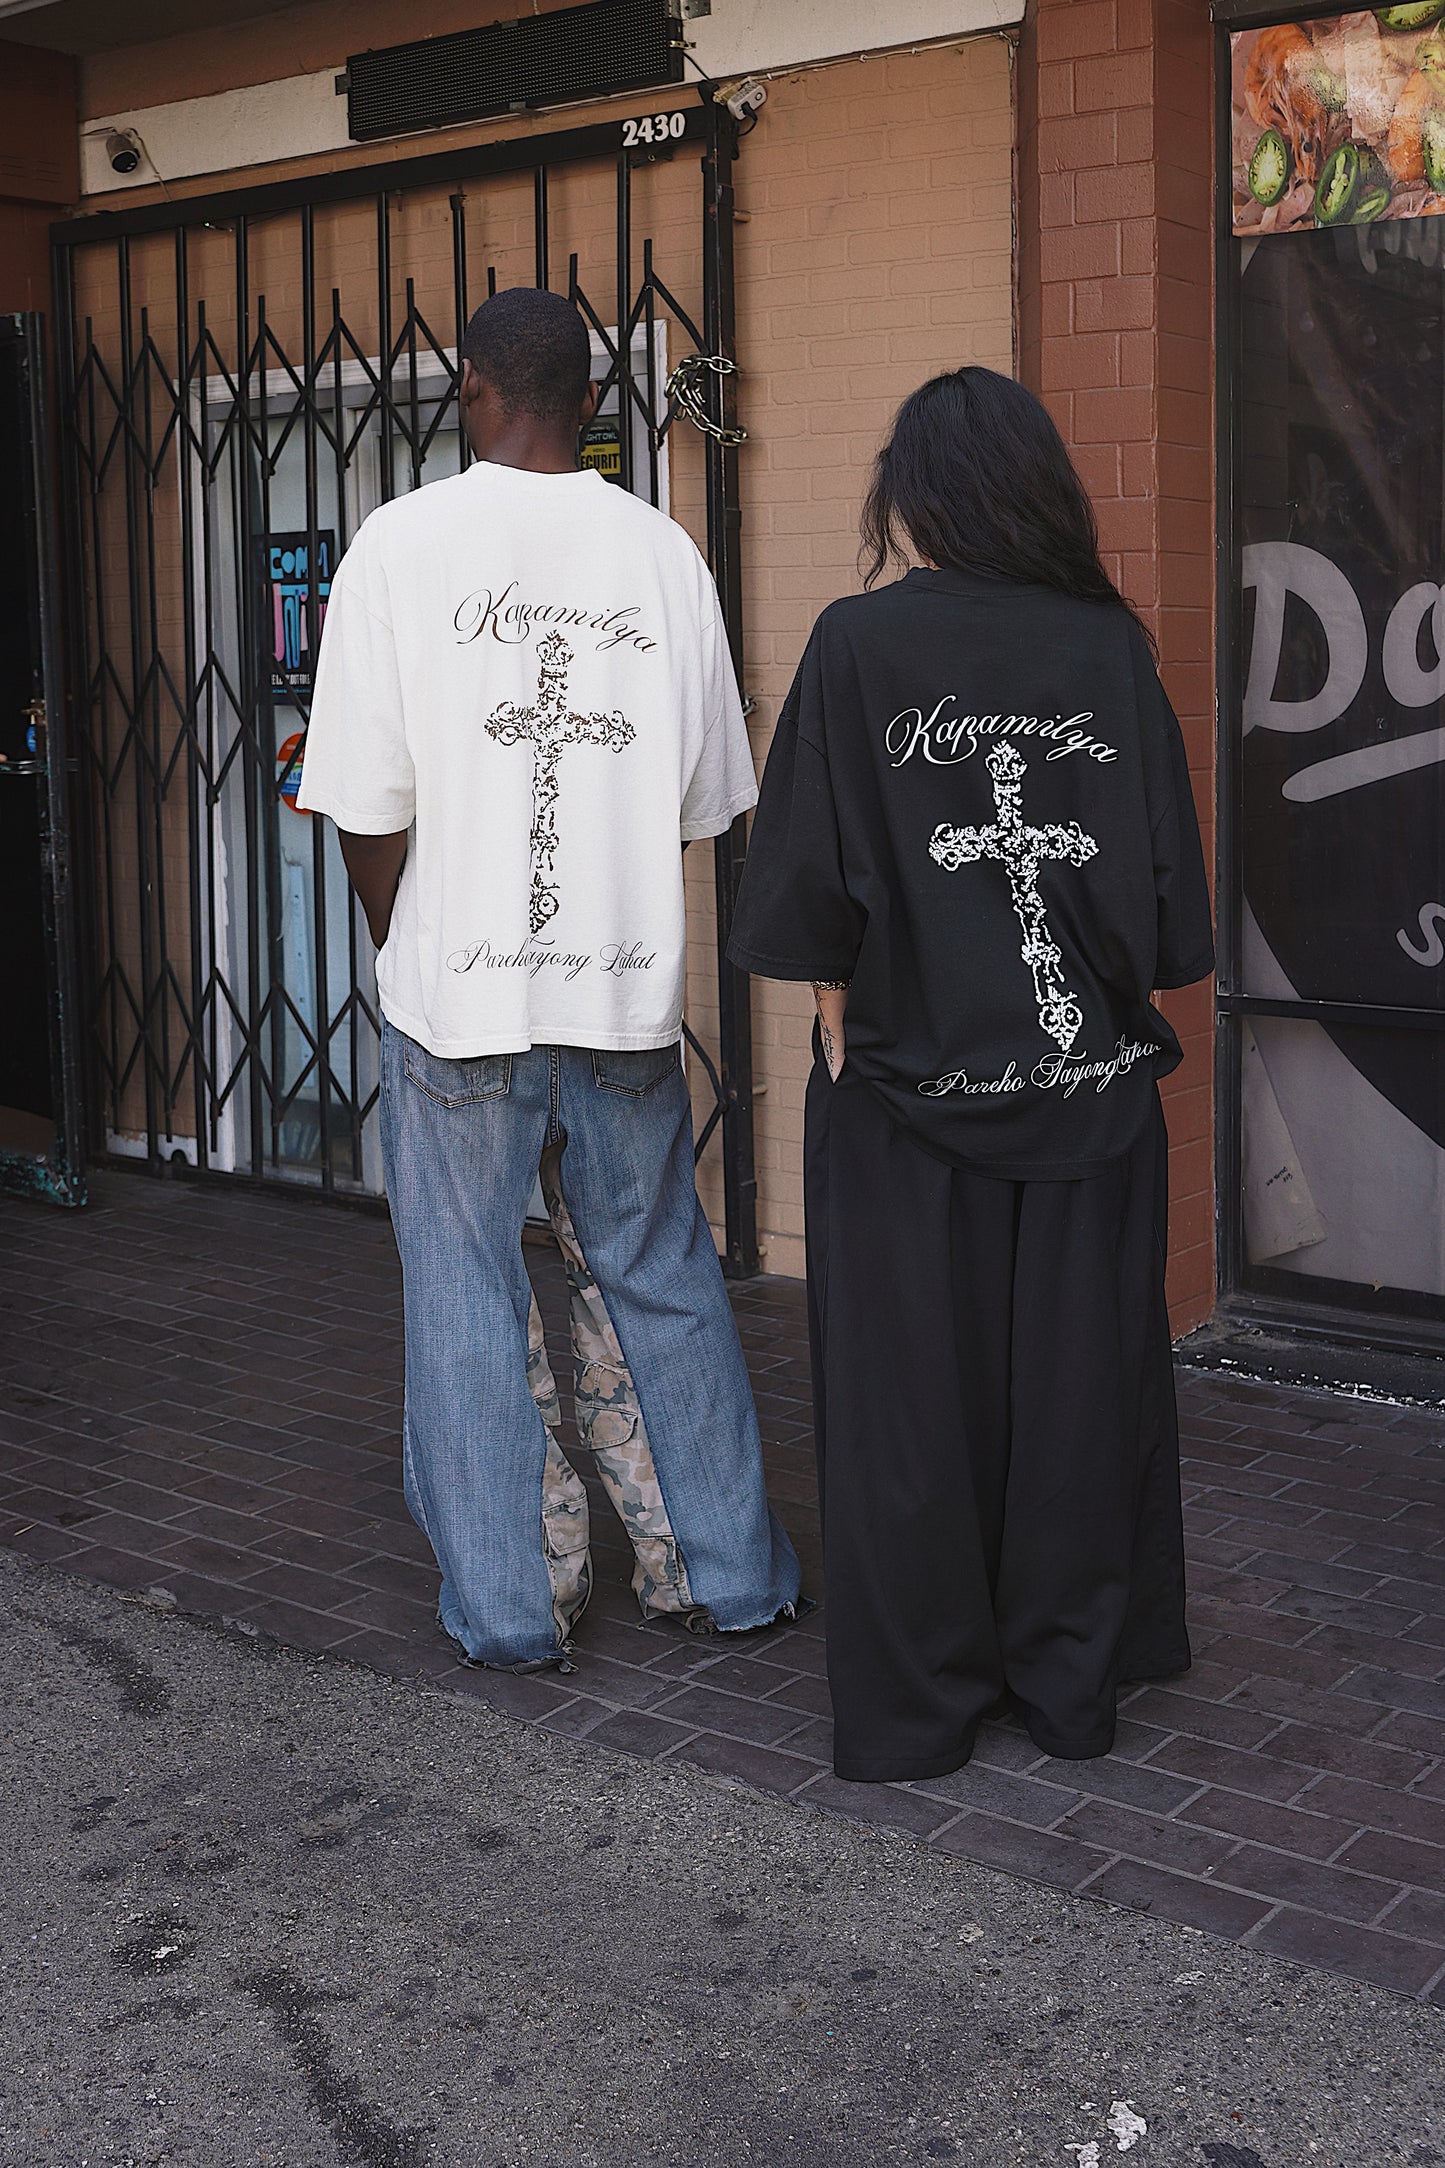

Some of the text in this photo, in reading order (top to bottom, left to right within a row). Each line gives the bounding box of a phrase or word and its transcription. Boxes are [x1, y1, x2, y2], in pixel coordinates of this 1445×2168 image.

[622, 112, 686, 147] 2430
[580, 453, 620, 470] ECURIT
[454, 580, 658, 653] Kapamilya
[885, 695, 1119, 767] Kapamilya
[917, 1033, 1162, 1099] Pareho Tayong Laha
